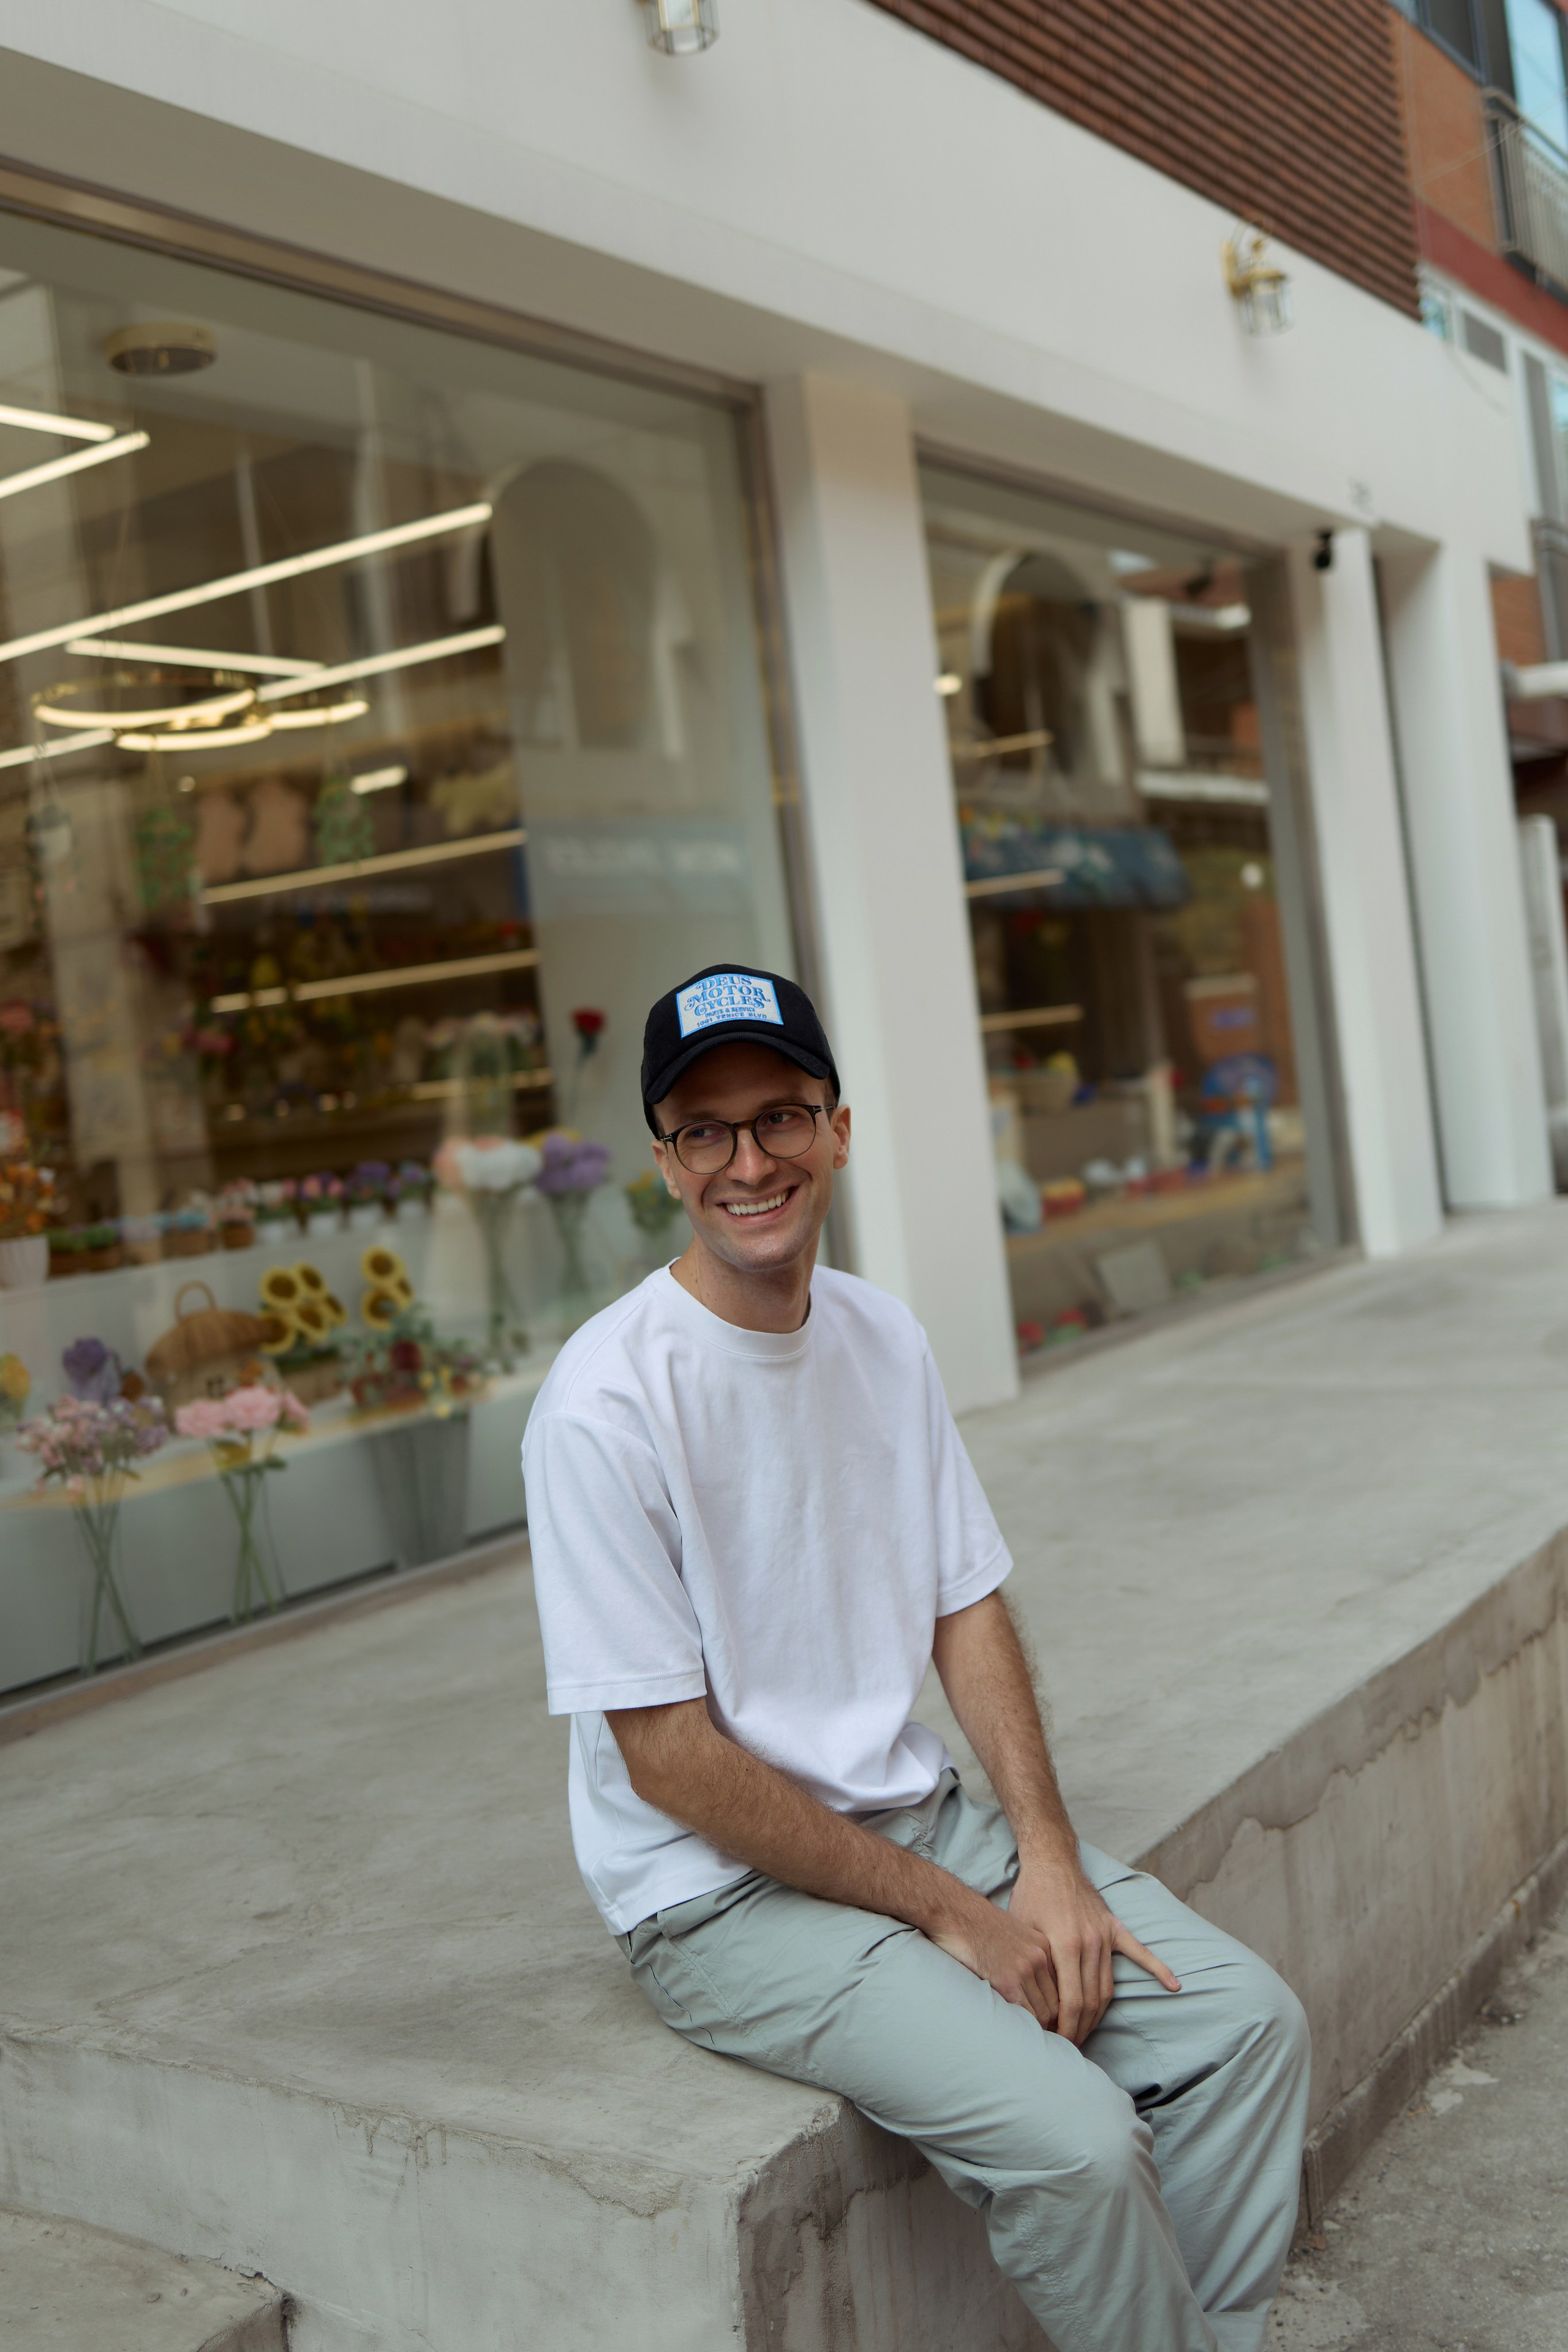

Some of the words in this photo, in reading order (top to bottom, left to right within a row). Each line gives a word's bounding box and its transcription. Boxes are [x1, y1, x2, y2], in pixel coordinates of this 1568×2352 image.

[695, 976, 752, 990] DEUS
[684, 985, 771, 1011] MOTOR
[694, 995, 764, 1016] CYCLES
[705, 1009, 723, 1017] PARTS
